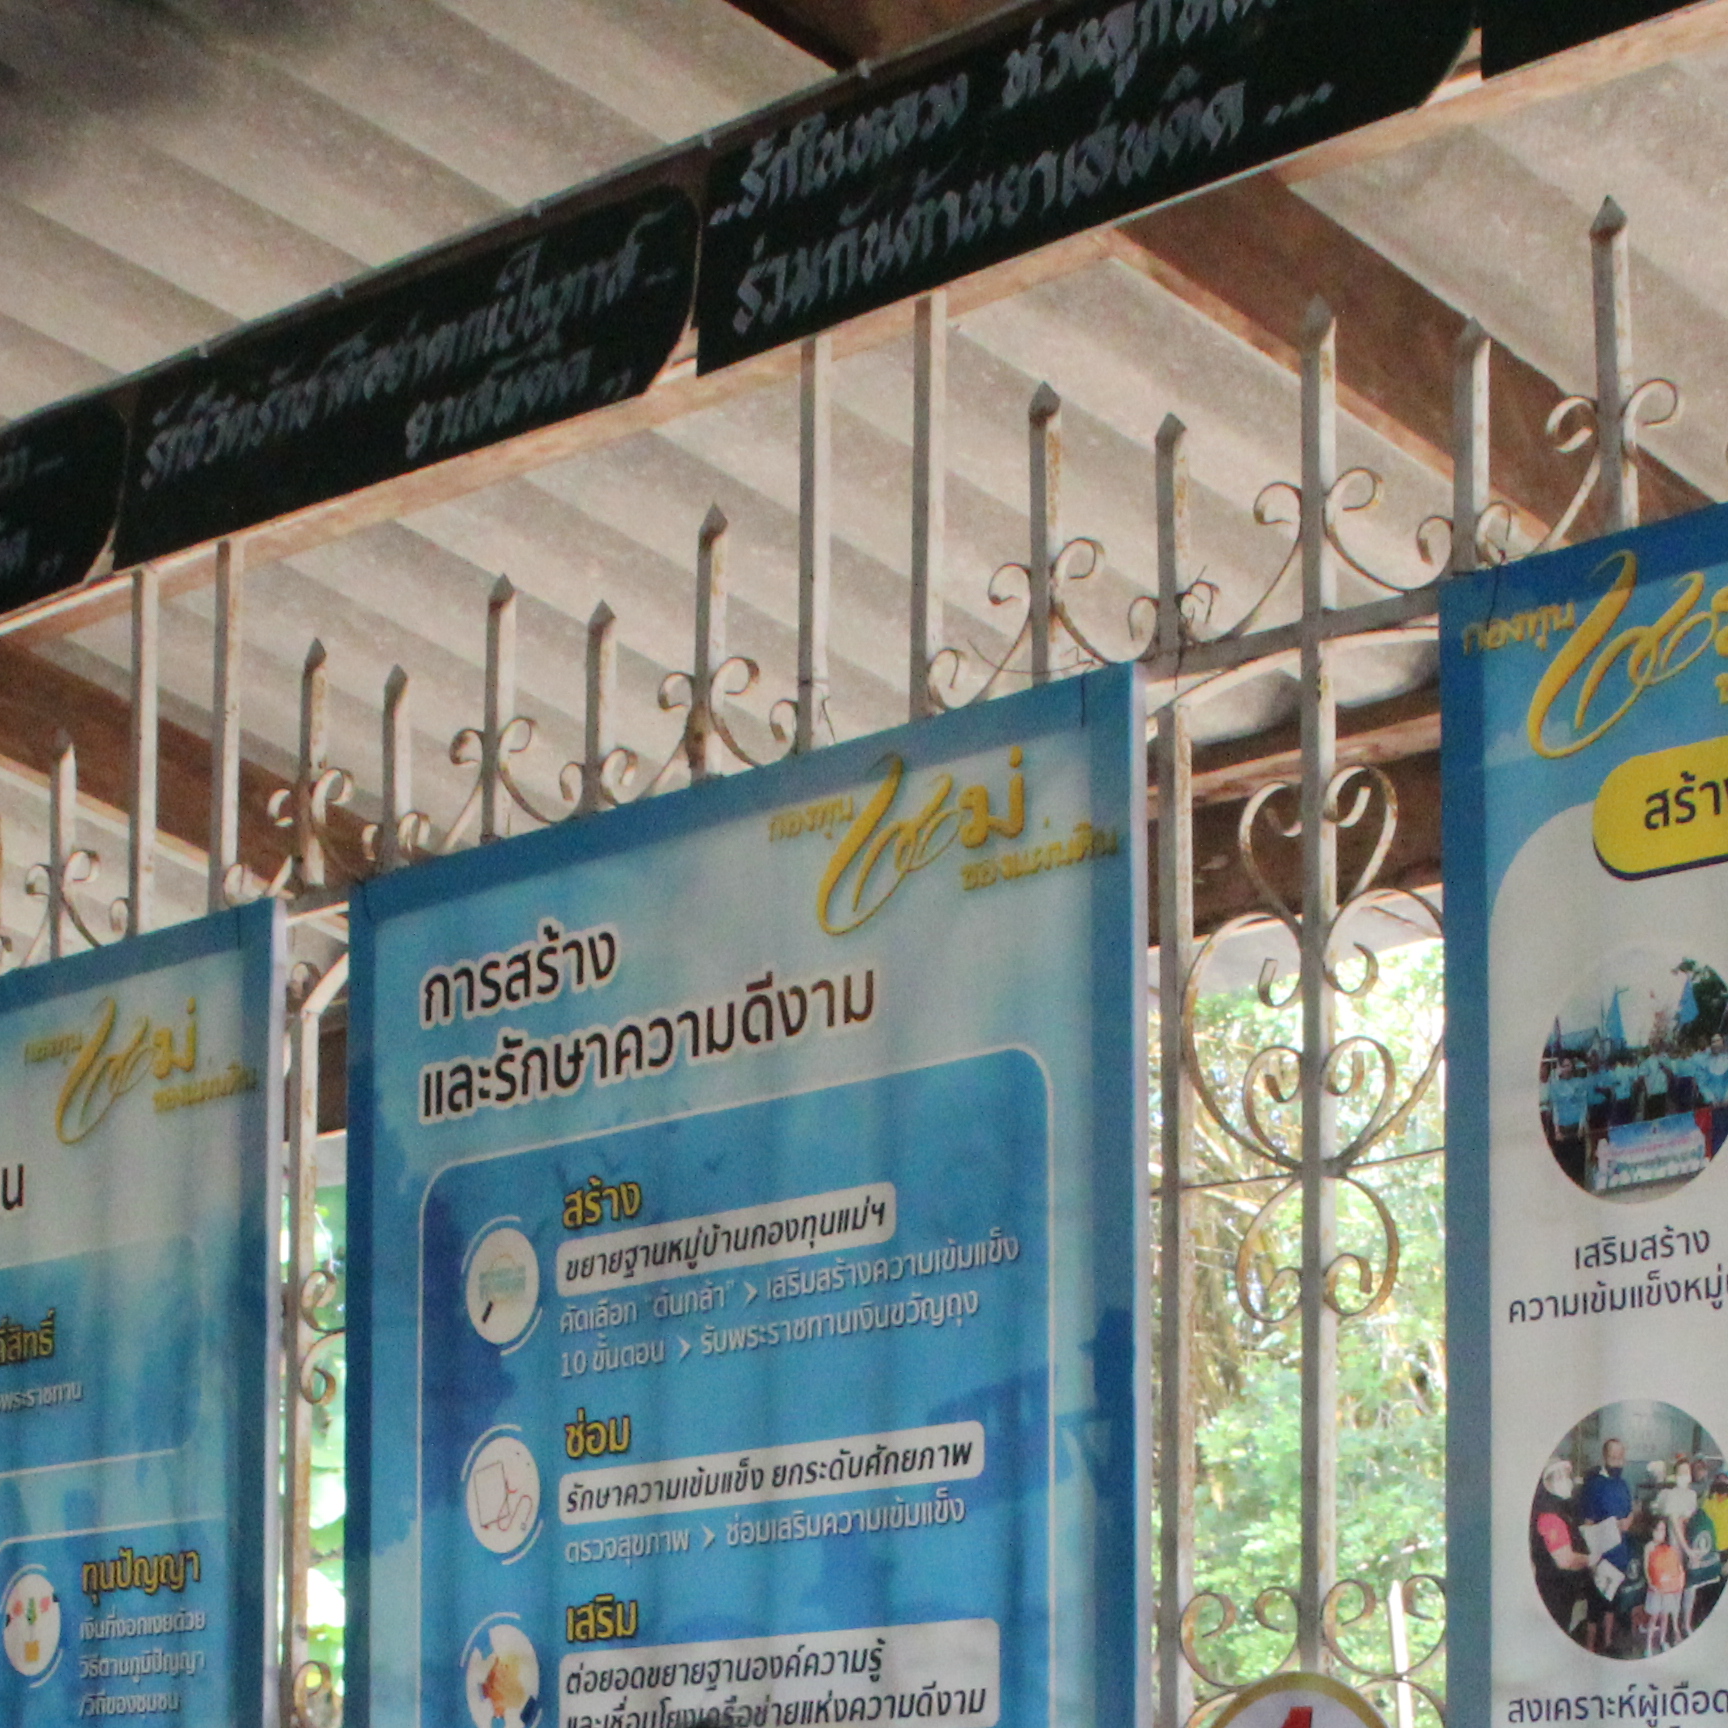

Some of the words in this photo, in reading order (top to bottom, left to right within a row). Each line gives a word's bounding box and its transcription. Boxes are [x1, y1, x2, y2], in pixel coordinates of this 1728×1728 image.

[424, 925, 616, 1022] การสร้าง
[423, 970, 874, 1117] และรักษาความดีงาม
[562, 1175, 641, 1229] สร้าง
[1574, 1224, 1711, 1271] เสริมสร้าง
[561, 1351, 587, 1379] 10
[566, 1458, 764, 1513] รักษาความเข้มแข็ง
[772, 1438, 973, 1488] ยกระดับศักยภาพ
[565, 1594, 639, 1642] เสริม
[566, 1637, 886, 1696] ต่อยอดขยายฐานองค์ความรู้
